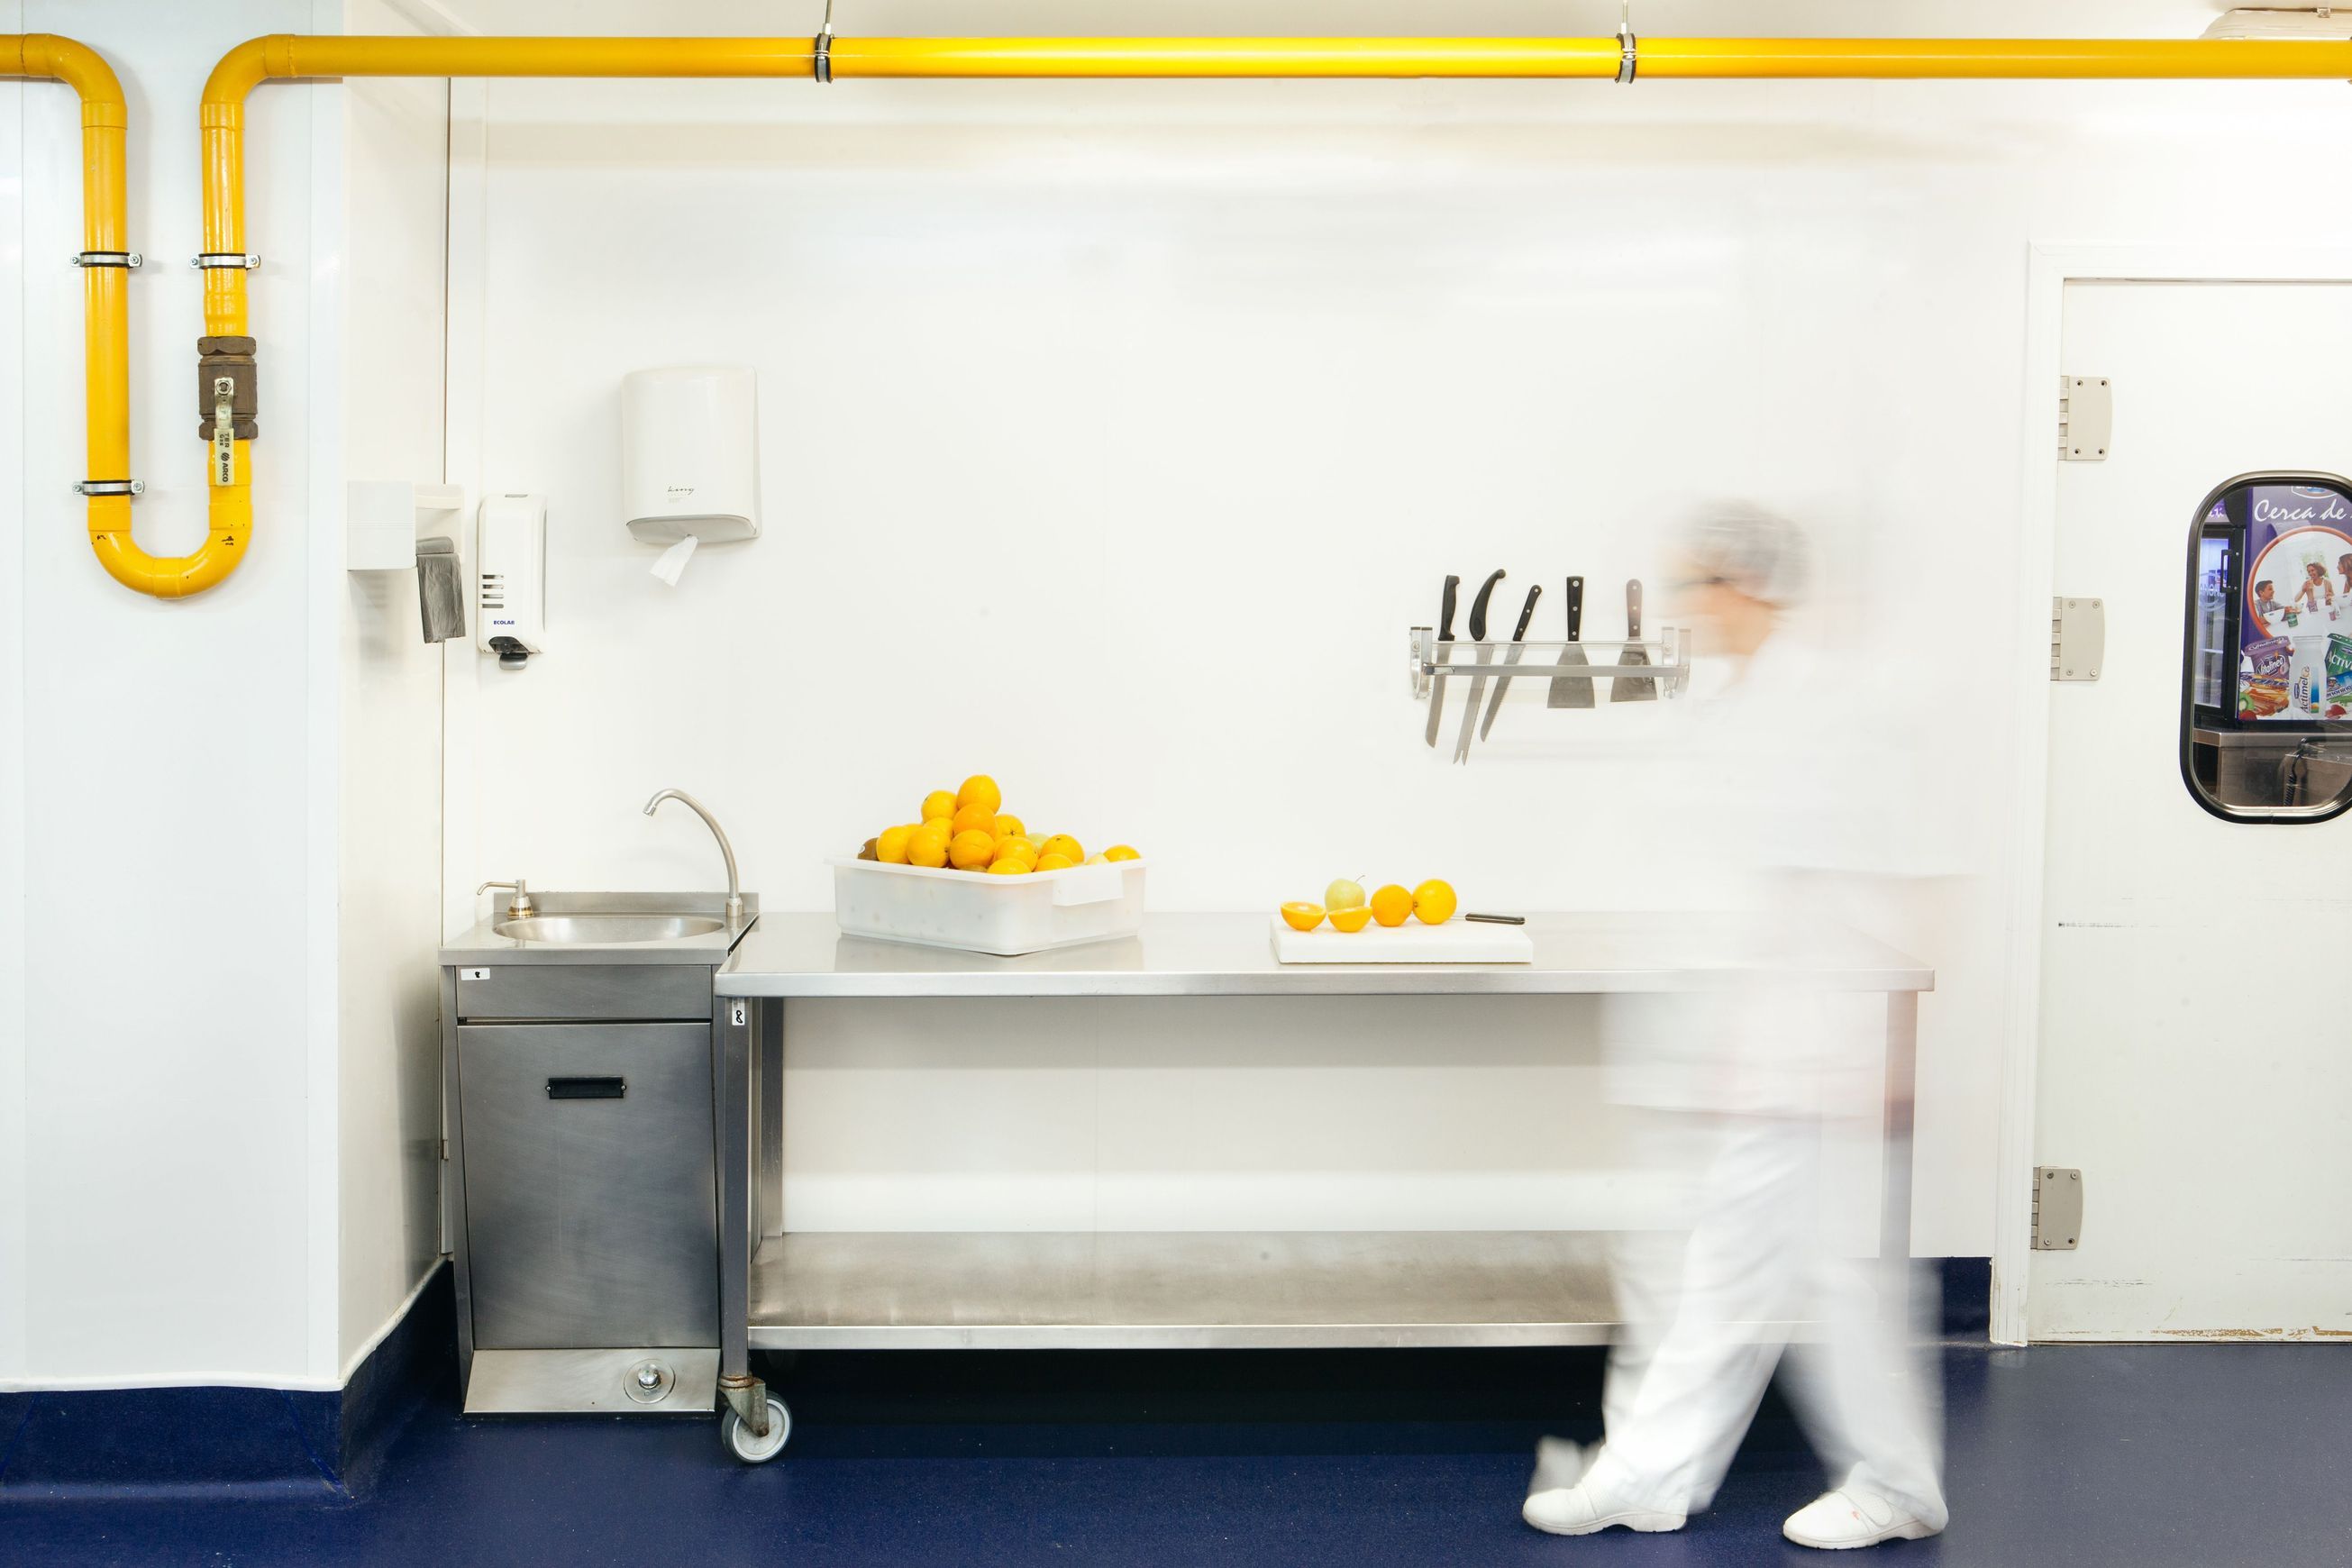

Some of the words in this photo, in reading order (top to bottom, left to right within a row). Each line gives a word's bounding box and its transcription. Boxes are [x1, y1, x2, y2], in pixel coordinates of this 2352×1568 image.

[2254, 499, 2317, 522] Cerca
[2319, 498, 2347, 520] de
[2300, 677, 2309, 714] Actimel
[735, 1009, 743, 1024] 8
